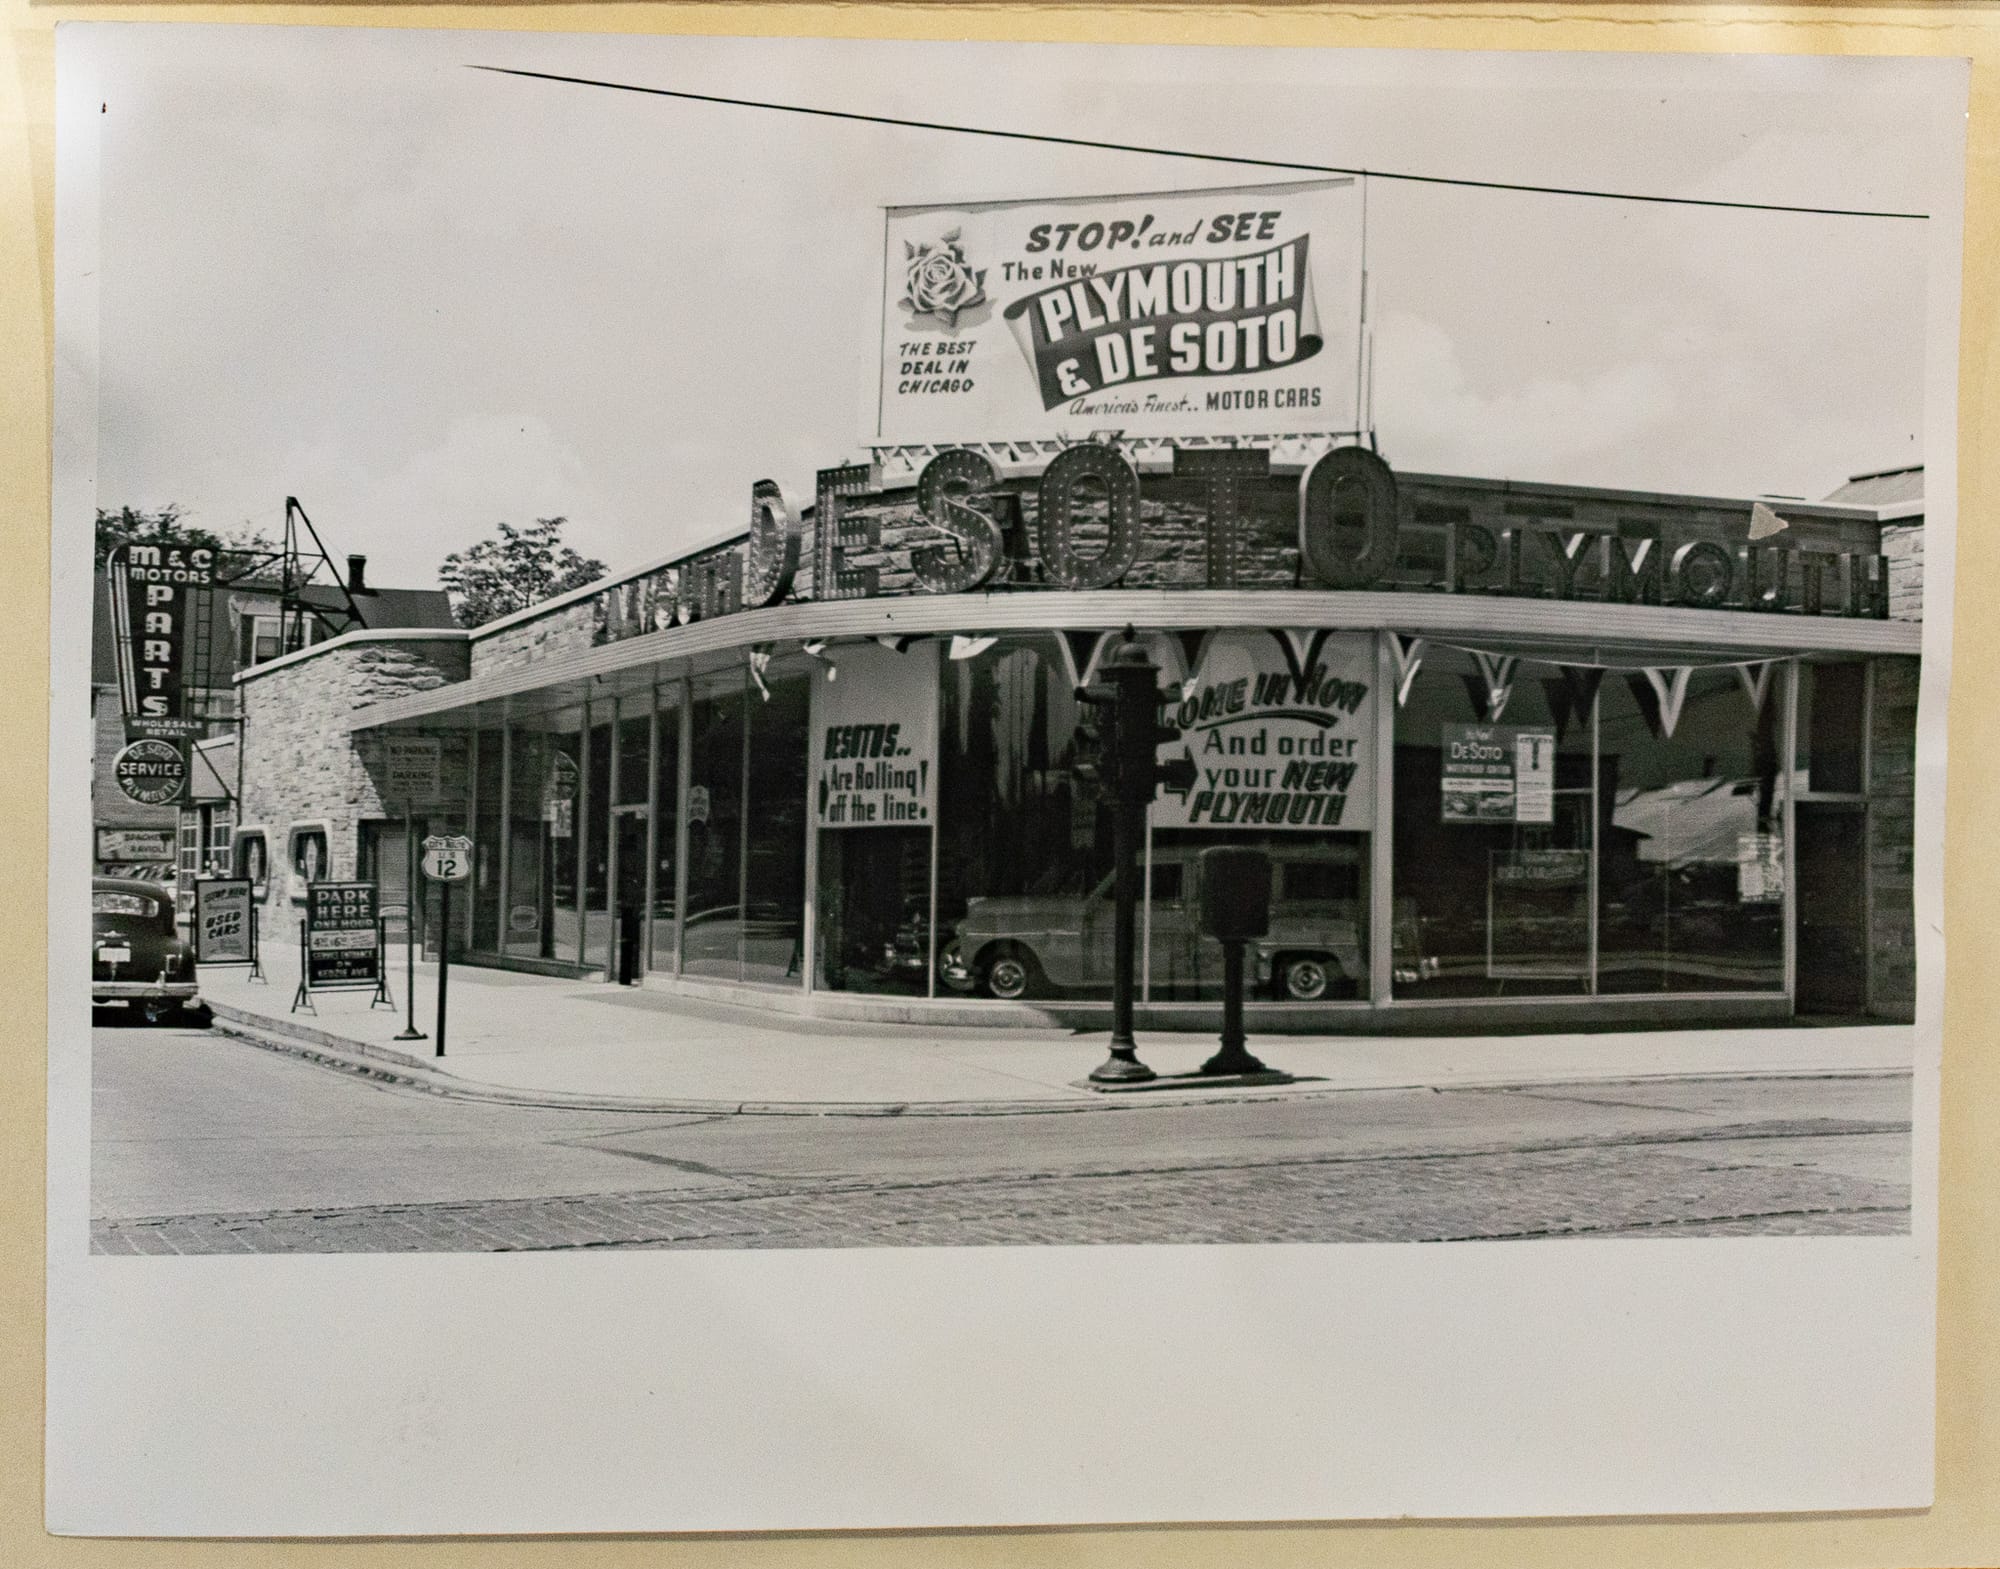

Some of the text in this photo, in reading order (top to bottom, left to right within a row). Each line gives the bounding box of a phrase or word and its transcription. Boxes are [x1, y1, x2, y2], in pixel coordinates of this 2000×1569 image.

[1026, 211, 1281, 253] STOP! and SEE
[1002, 259, 1098, 281] The New
[1038, 243, 1296, 343] PLYMOUTH
[899, 340, 977, 357] THE BEST
[1056, 308, 1298, 397] & DE SOTO
[901, 359, 969, 375] DEAL IN
[898, 378, 975, 395] CHICAGO
[1069, 396, 1139, 416] America's
[1206, 389, 1269, 411] MOTOR
[1274, 386, 1322, 409] CARS
[129, 546, 213, 569] M & C
[130, 568, 211, 584] MOTORS
[1446, 521, 1889, 620] PLYMOUTH
[141, 584, 174, 718] PARTS
[131, 719, 203, 729] WHOLESALE
[146, 729, 187, 737] RETAIL
[1203, 729, 1358, 757] And order
[119, 762, 182, 776] SERVICE
[830, 763, 853, 791] Are
[1205, 760, 1359, 793] your NEW
[121, 777, 180, 802] PLYMOUTH
[829, 794, 847, 822] off
[851, 793, 876, 822] the
[1188, 791, 1348, 826] PLYMOUTH
[436, 859, 457, 877] 12
[316, 890, 370, 904] PARK
[206, 911, 241, 928] USED
[316, 904, 370, 919] HERE
[208, 923, 241, 939] CARS
[313, 919, 374, 929] ONE HOUR
